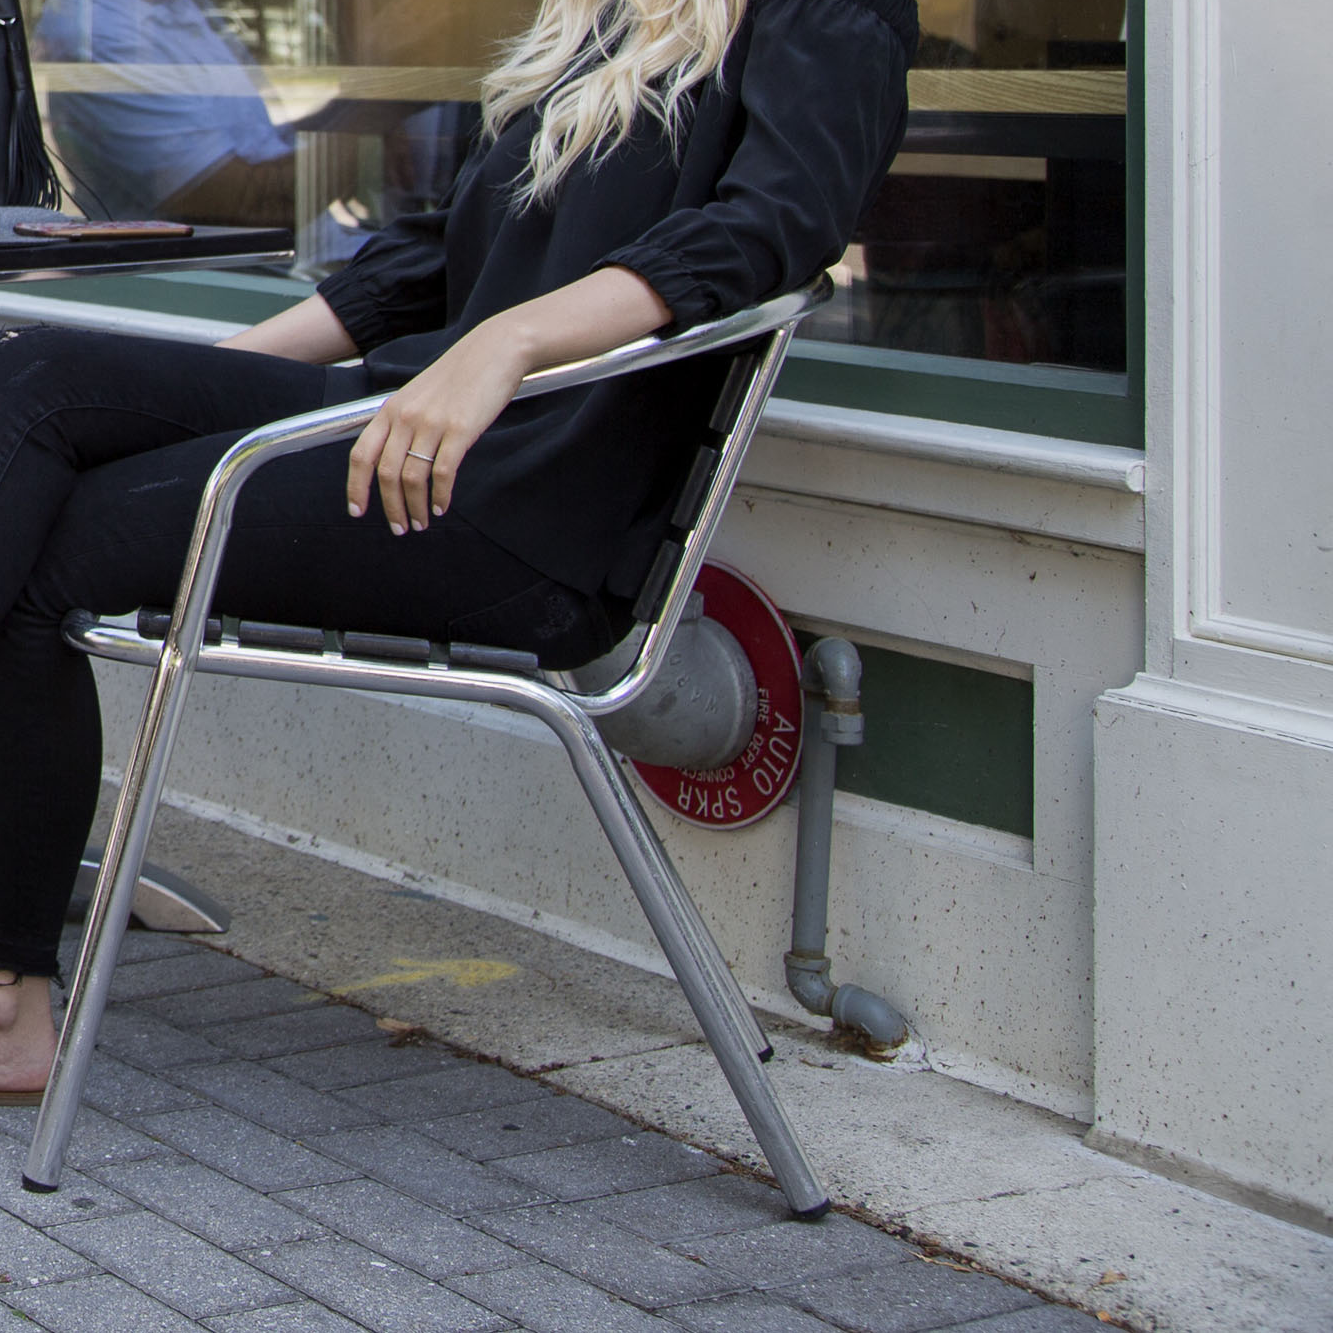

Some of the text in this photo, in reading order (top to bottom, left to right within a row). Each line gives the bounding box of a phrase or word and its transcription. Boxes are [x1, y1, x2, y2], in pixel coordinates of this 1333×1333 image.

[758, 687, 770, 726] FIRE
[677, 711, 796, 819] AUTO SPKR
[743, 732, 765, 770] DEPT
